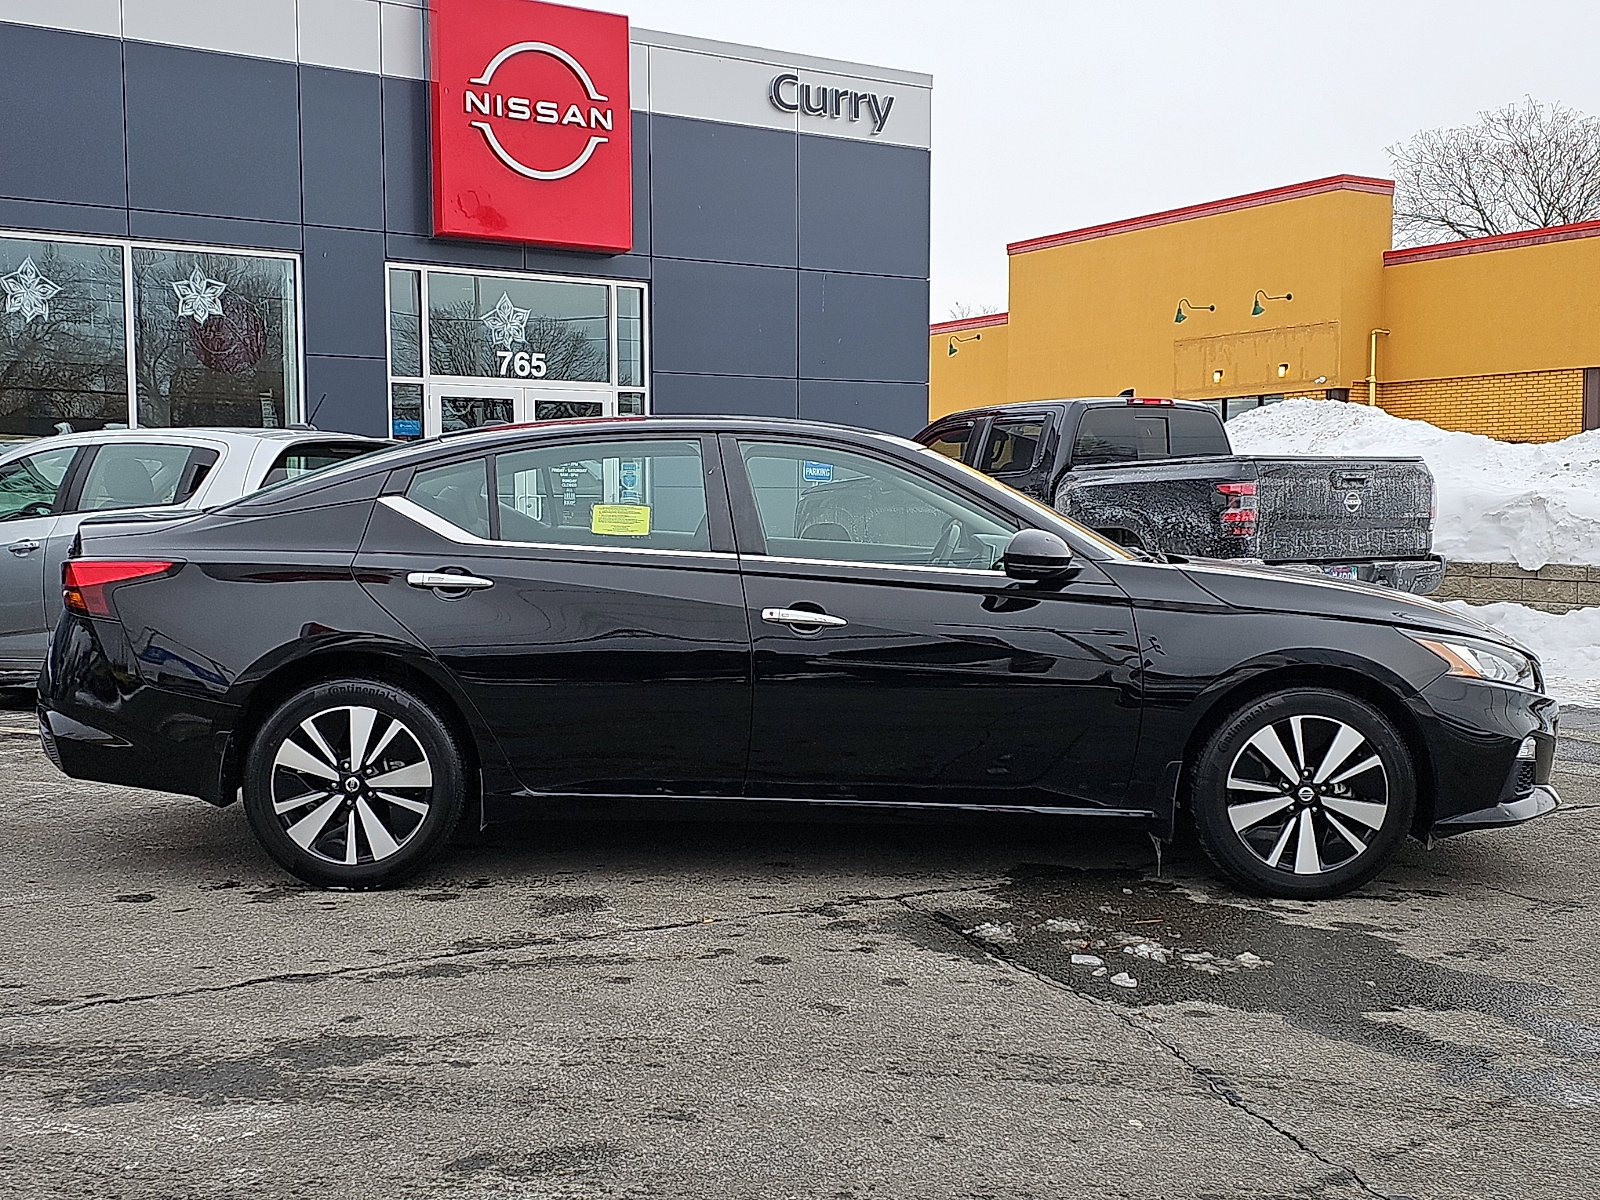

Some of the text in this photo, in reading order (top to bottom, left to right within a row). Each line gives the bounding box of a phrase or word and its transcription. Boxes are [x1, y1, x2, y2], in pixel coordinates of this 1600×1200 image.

[465, 90, 613, 131] NISSAN
[769, 74, 894, 134] Curry
[496, 350, 547, 377] 765
[805, 467, 830, 477] PARKING
